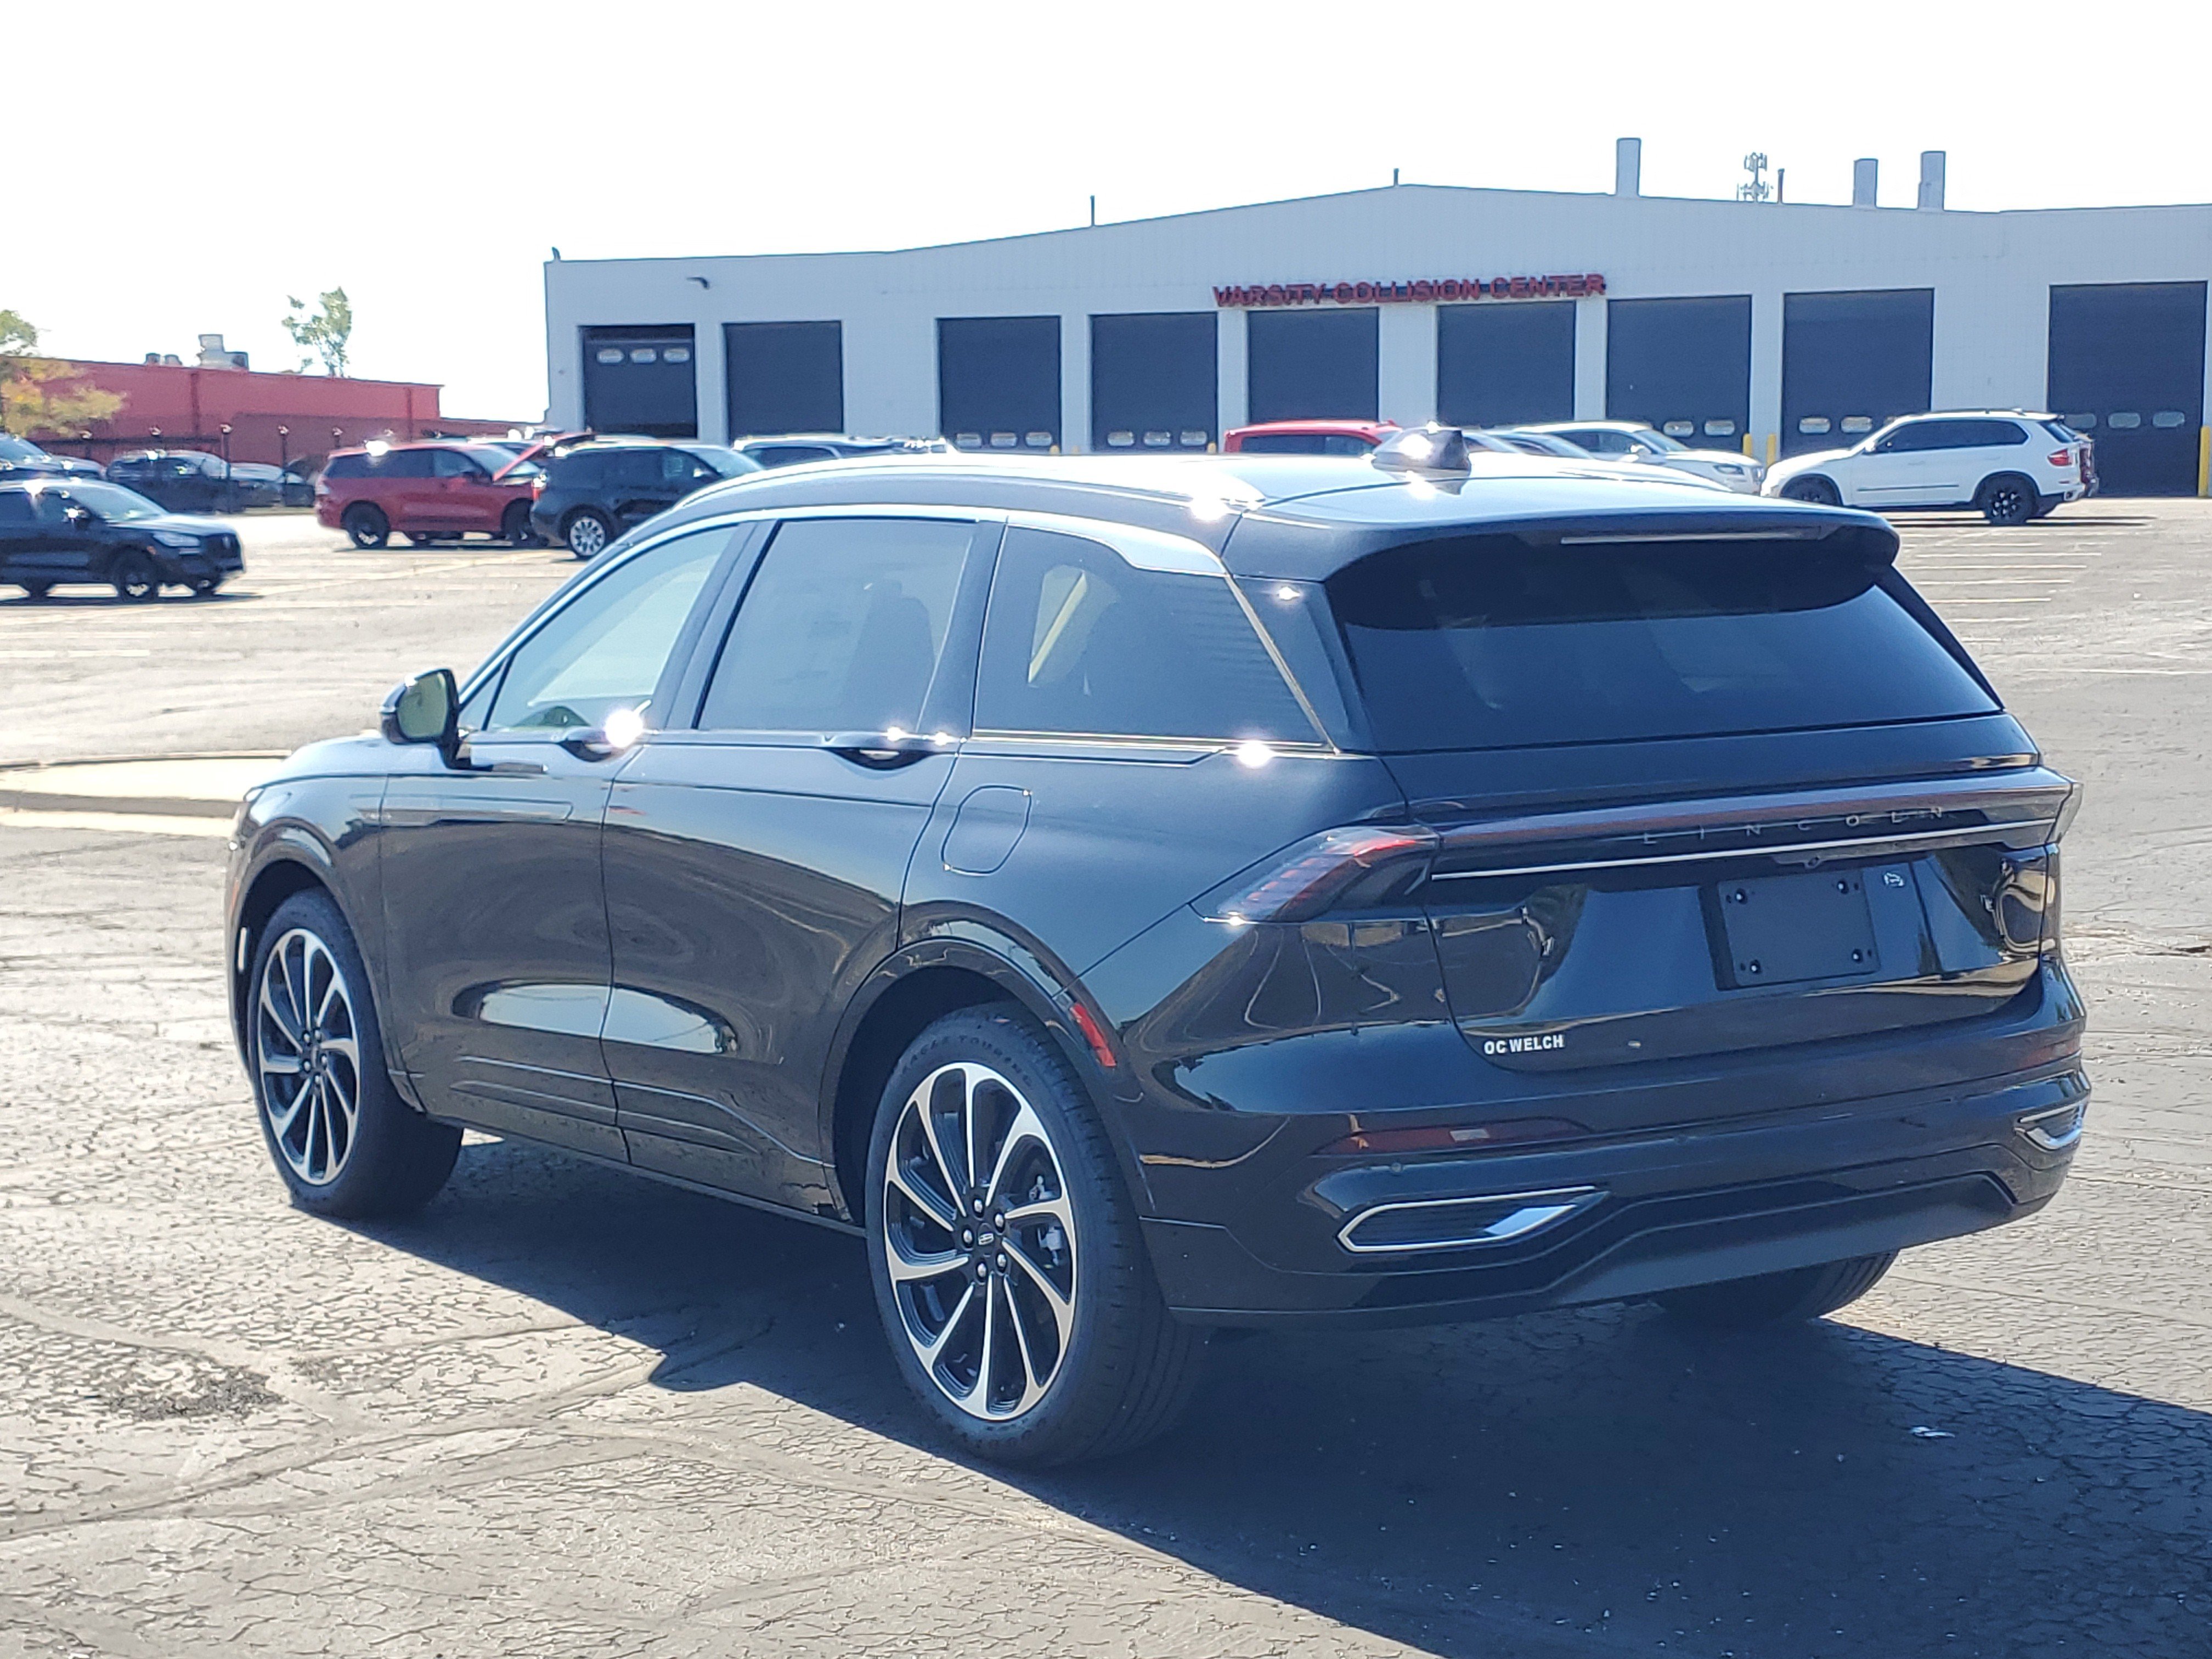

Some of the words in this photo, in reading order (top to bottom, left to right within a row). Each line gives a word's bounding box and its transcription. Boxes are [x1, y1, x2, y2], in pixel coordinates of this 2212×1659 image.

[1212, 283, 1327, 307] VARSITY
[1333, 278, 1480, 304] COLLISION
[1489, 273, 1606, 299] CENTER
[1642, 806, 1943, 845] LINCOLN
[1483, 1040, 1506, 1055] OC
[1509, 1034, 1565, 1053] WELCH
